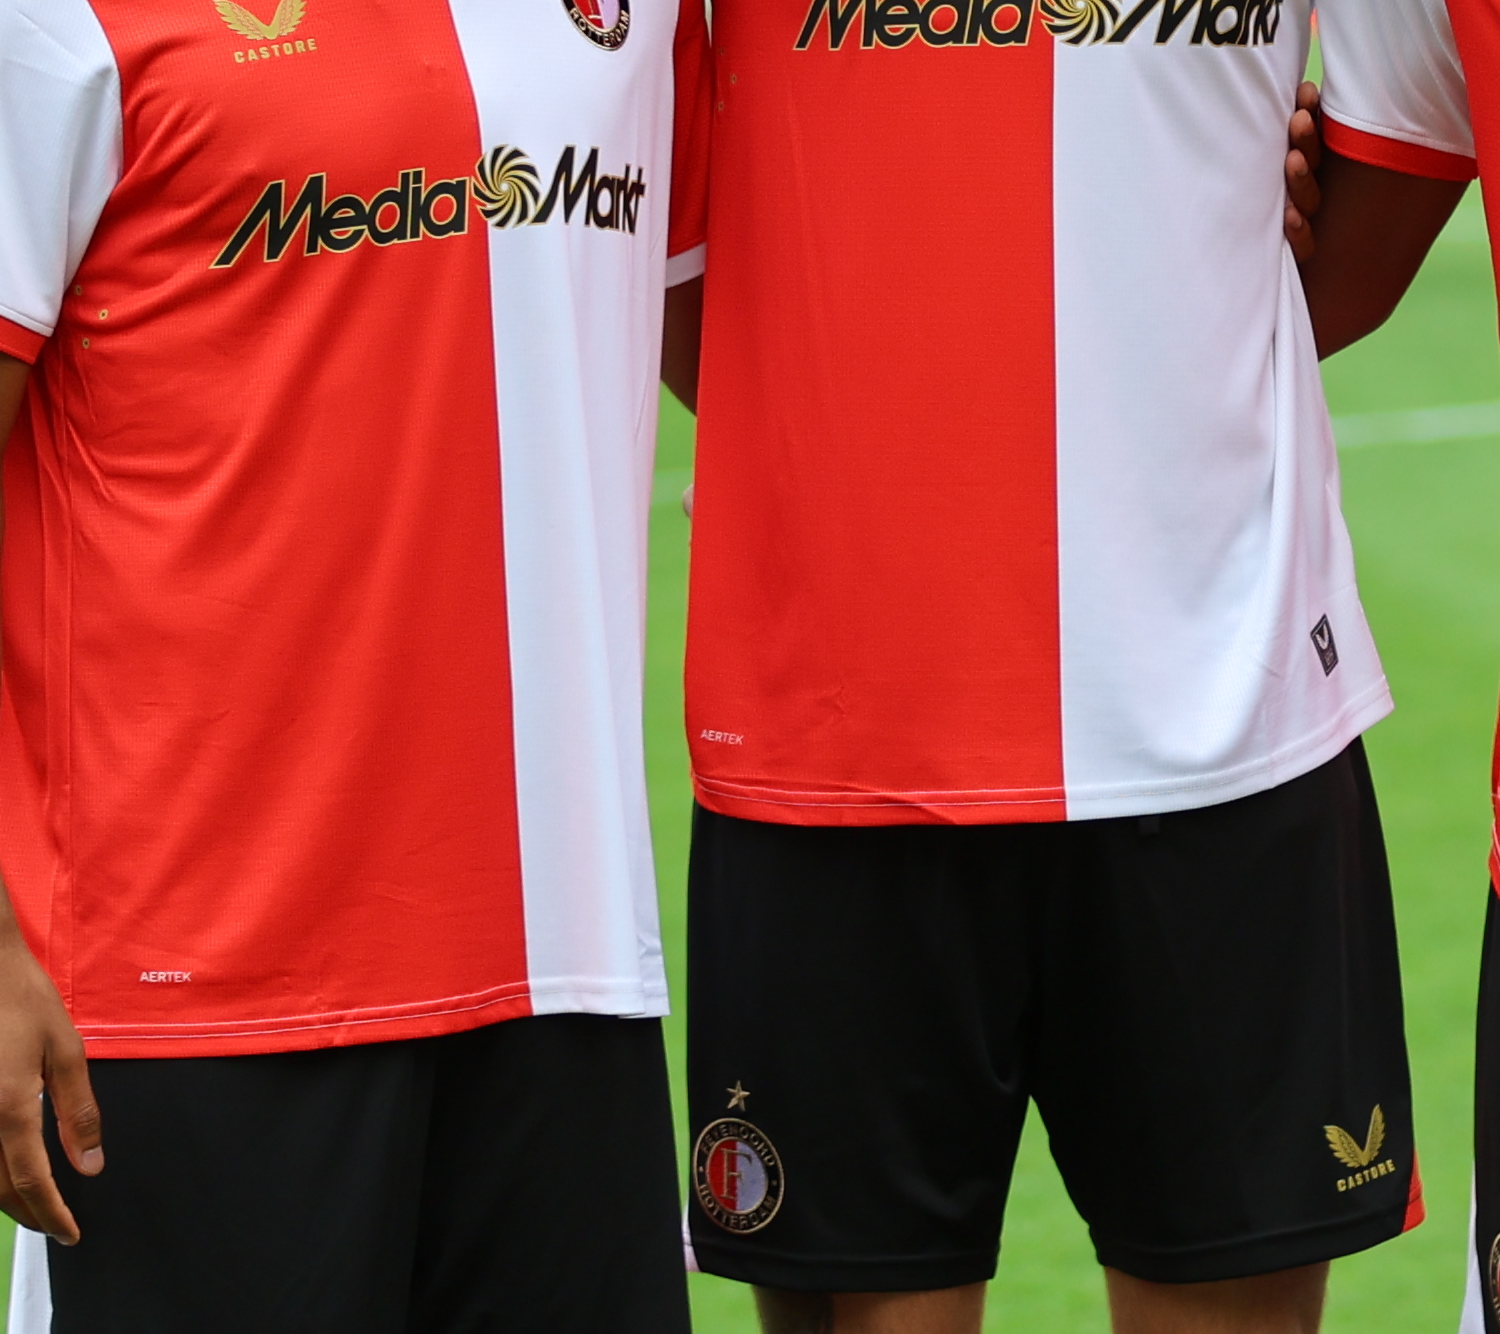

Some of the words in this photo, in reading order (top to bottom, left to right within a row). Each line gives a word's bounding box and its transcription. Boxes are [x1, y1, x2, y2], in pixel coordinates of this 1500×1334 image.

[570, 7, 629, 46] ROTTERDAM
[234, 38, 318, 64] CASTORE
[209, 168, 472, 268] Media
[528, 145, 646, 235] Markt
[700, 728, 744, 745] AERTEK
[140, 971, 192, 983] AERTEK
[1336, 1159, 1396, 1192] CASTORE
